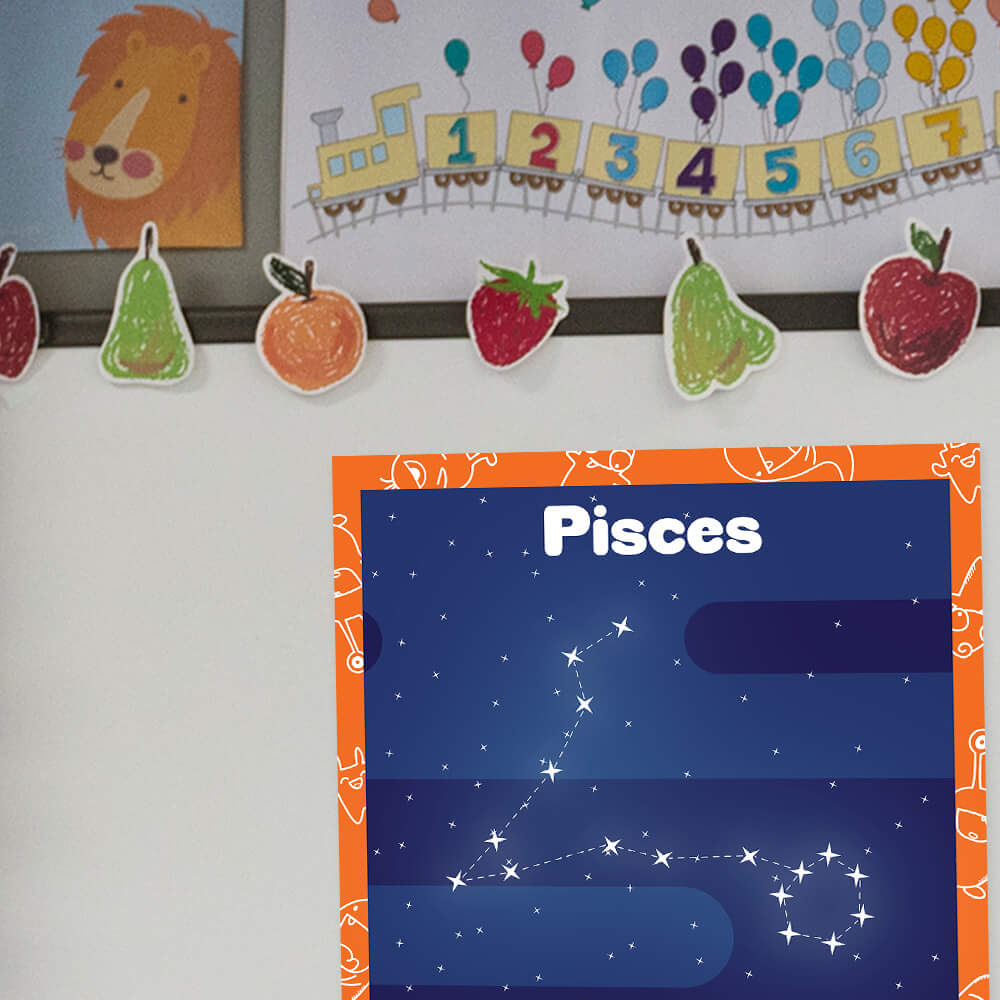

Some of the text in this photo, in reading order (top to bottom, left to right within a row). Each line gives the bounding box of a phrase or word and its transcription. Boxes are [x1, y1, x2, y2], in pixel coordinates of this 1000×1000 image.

[448, 117, 476, 165] 1
[529, 122, 559, 171] 2
[605, 133, 639, 181] 3
[676, 146, 717, 194] 4
[765, 147, 798, 193] 5
[843, 130, 880, 178] 6
[923, 109, 962, 157] 7
[543, 504, 763, 557] Pisces
